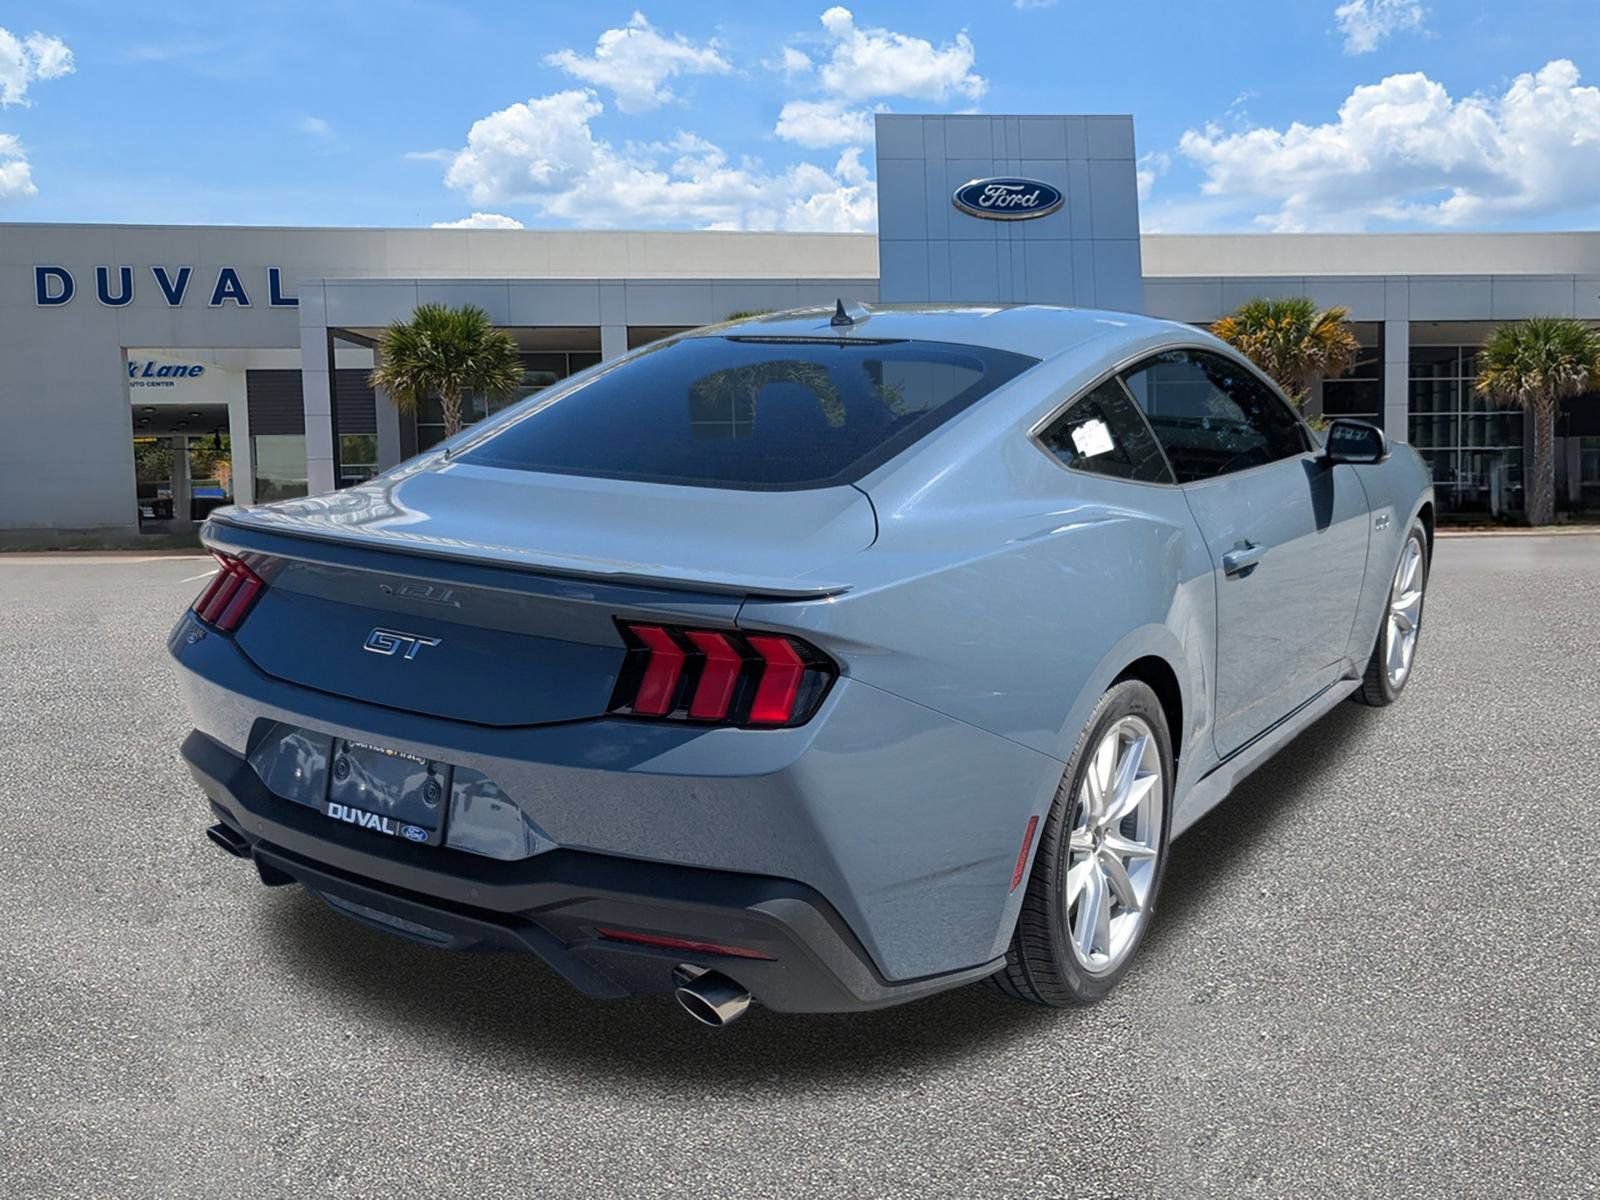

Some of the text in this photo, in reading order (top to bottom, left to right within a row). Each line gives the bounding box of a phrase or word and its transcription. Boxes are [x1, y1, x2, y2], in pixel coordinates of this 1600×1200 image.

[978, 184, 1040, 208] Ford
[34, 266, 299, 307] DUVAL
[141, 361, 205, 378] Lane
[363, 626, 443, 660] GT
[327, 802, 426, 841] DUVAL Ford
